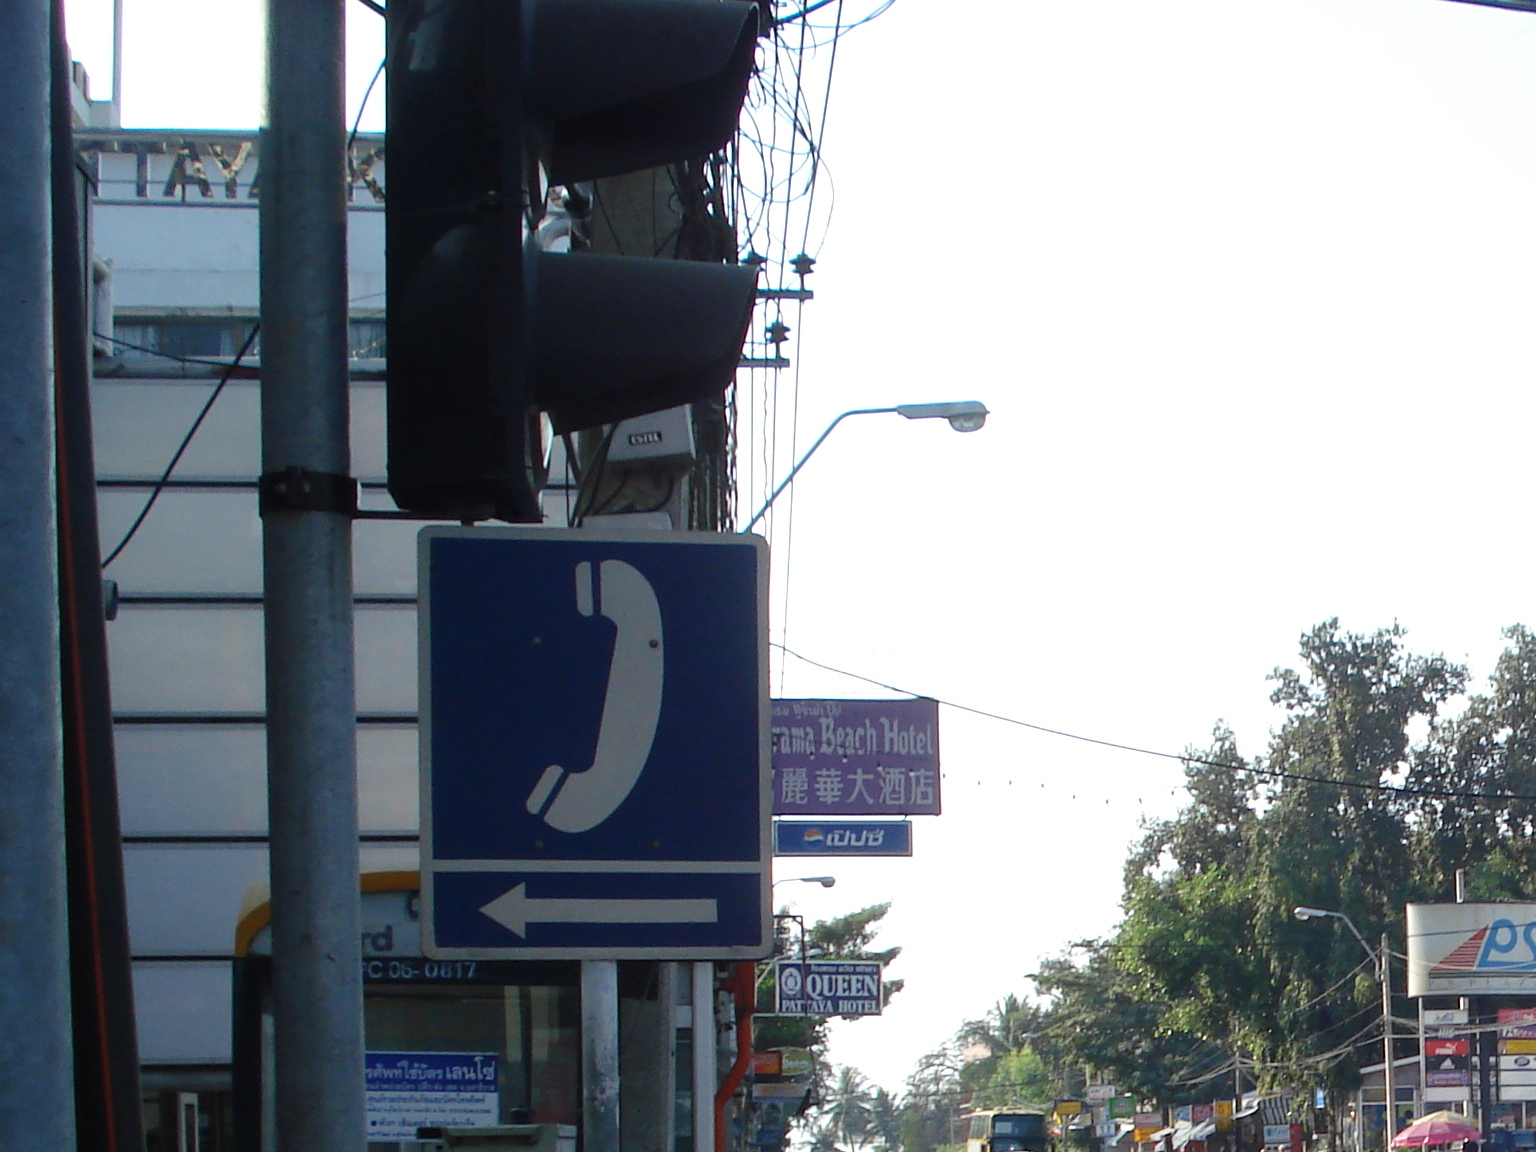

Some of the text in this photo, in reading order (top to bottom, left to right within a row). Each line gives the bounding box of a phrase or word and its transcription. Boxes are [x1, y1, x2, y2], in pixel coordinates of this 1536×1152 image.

[76, 137, 259, 199] TTAY
[819, 717, 877, 755] Beach
[880, 716, 934, 755] Hotel
[772, 767, 935, 805] 麗華大酒店
[425, 961, 477, 978] 0817
[806, 973, 879, 999] QUEEN
[782, 1000, 879, 1014] PATTAYA HOTEL
